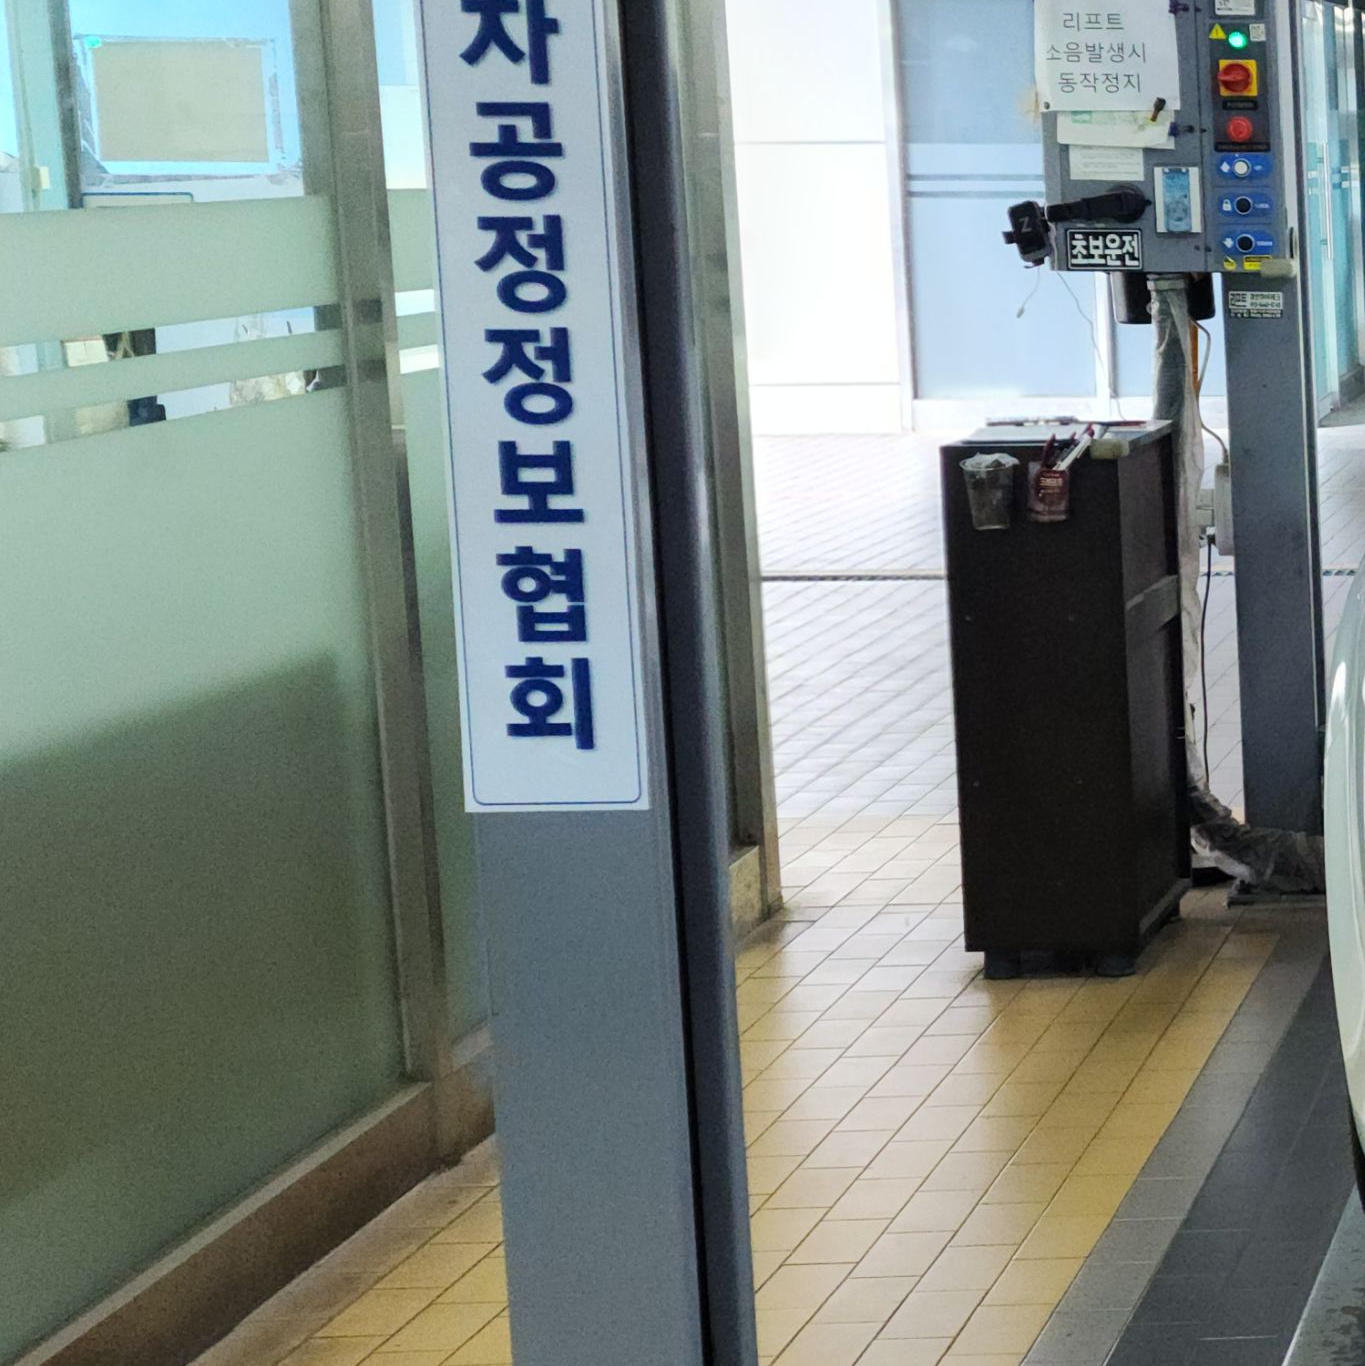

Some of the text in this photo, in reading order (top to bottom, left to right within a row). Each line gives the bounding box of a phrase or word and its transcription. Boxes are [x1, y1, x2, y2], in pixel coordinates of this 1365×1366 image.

[1063, 12, 1124, 32] 리프트
[1046, 41, 1147, 63] 소음발생시
[1058, 72, 1142, 94] 동작정지
[1071, 233, 1140, 267] 초보운전
